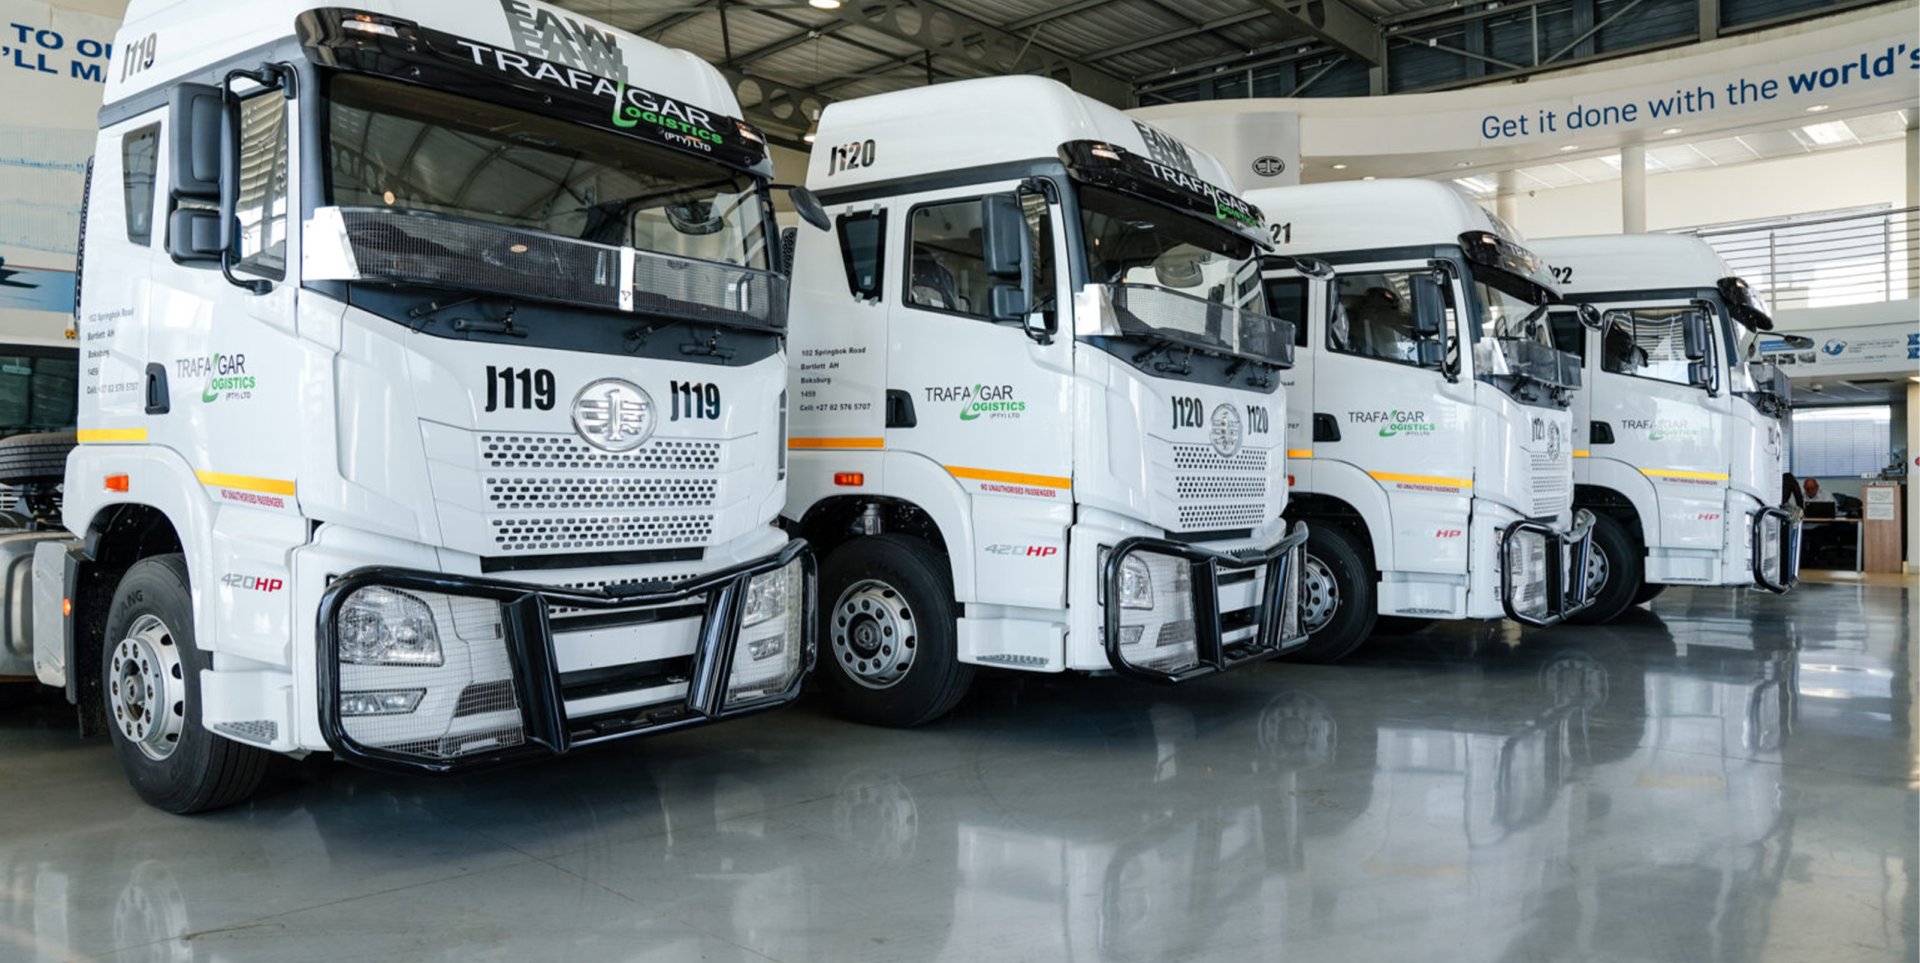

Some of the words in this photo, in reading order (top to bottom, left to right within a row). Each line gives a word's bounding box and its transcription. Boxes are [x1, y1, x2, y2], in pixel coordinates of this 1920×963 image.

[10, 23, 64, 50] TO
[120, 32, 157, 84] J119
[457, 40, 717, 132] TRAFALGAR
[1482, 115, 1529, 139] Get
[1539, 110, 1556, 133] it
[1566, 104, 1638, 130] done
[1648, 87, 1714, 118] with
[1726, 78, 1778, 105] the
[664, 132, 691, 147] (PTY)
[693, 140, 712, 152] LTD
[828, 139, 875, 176] J120
[814, 347, 847, 356] Springbok
[848, 346, 866, 354] Road
[485, 365, 556, 412] J119
[670, 380, 721, 422] J119
[925, 384, 1013, 401] TRAFALGAR
[1171, 395, 1204, 430] J120
[1246, 404, 1268, 435] J120
[221, 572, 283, 592] 420HP
